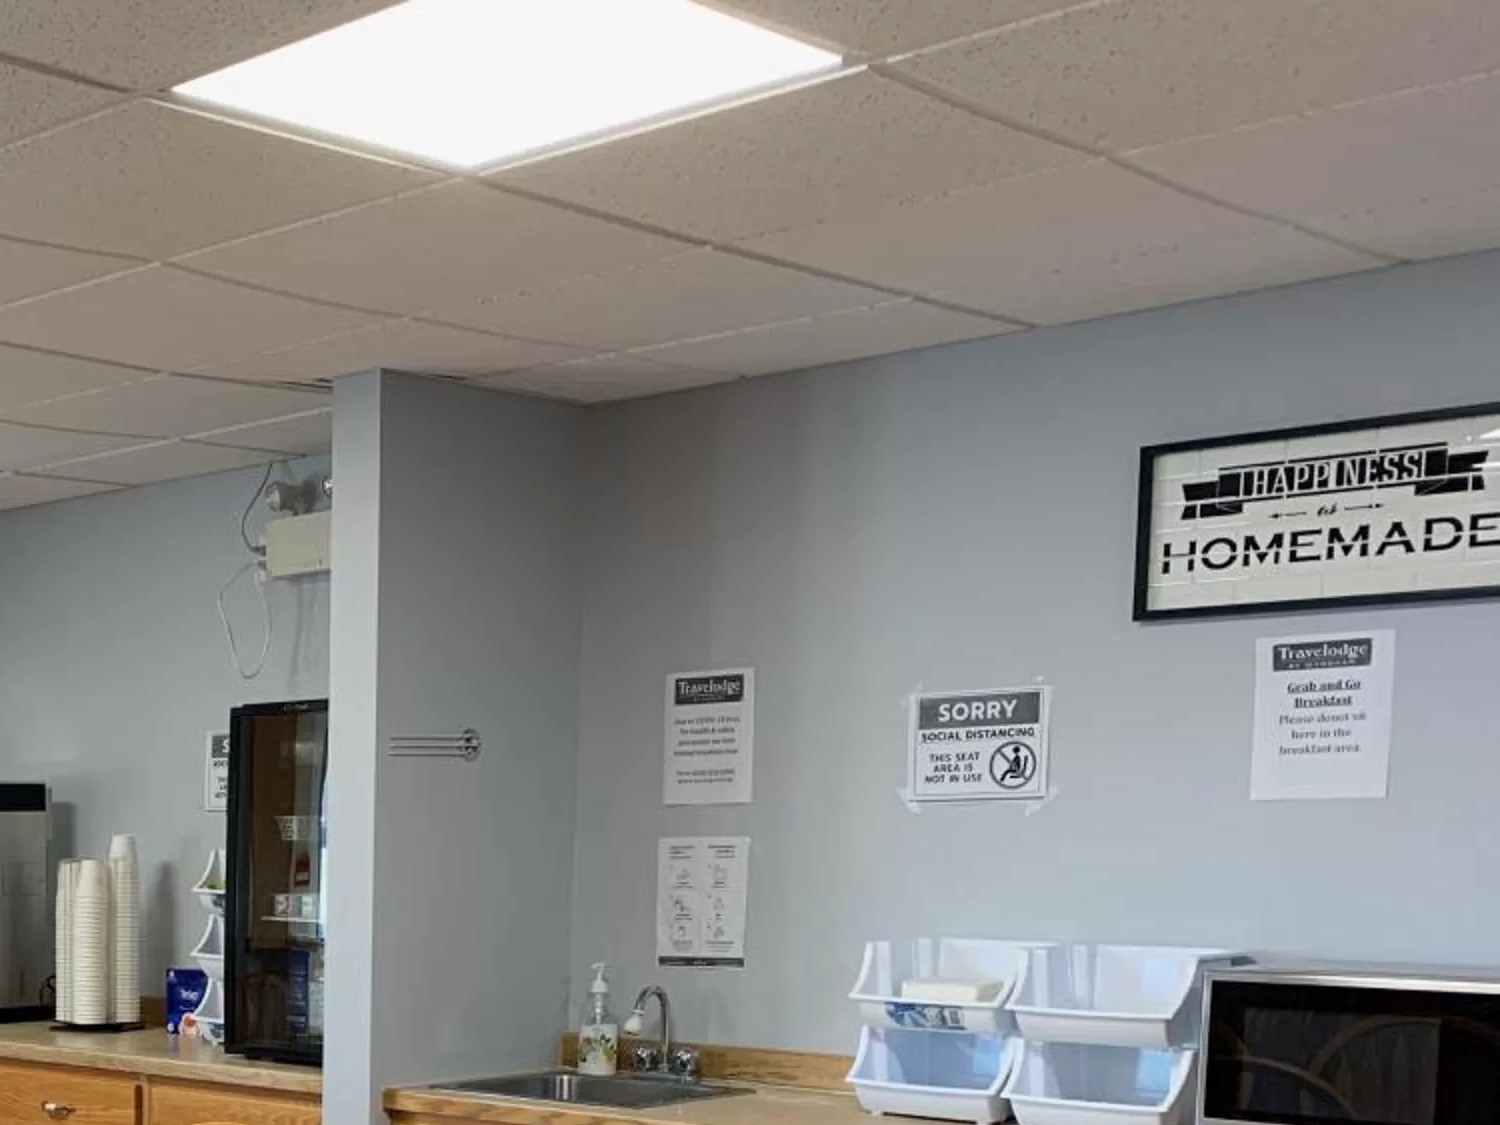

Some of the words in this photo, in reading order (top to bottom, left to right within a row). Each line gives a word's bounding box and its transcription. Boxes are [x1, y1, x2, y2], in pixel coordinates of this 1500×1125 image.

[1252, 452, 1423, 497] HAPPINESS
[1161, 512, 1500, 574] HOMEMADE
[1277, 643, 1368, 660] Travelodge
[1294, 695, 1353, 708] Breakfast
[938, 700, 1018, 722] SORRY
[921, 732, 961, 743] SOCIAL
[965, 727, 1035, 739] DISTANCING
[929, 753, 952, 762] THIS
[956, 752, 980, 761] SEAT
[933, 764, 960, 773] AREA
[964, 763, 973, 772] IS
[924, 775, 945, 784] NOT
[949, 774, 960, 783] IN
[963, 773, 983, 782] USE
